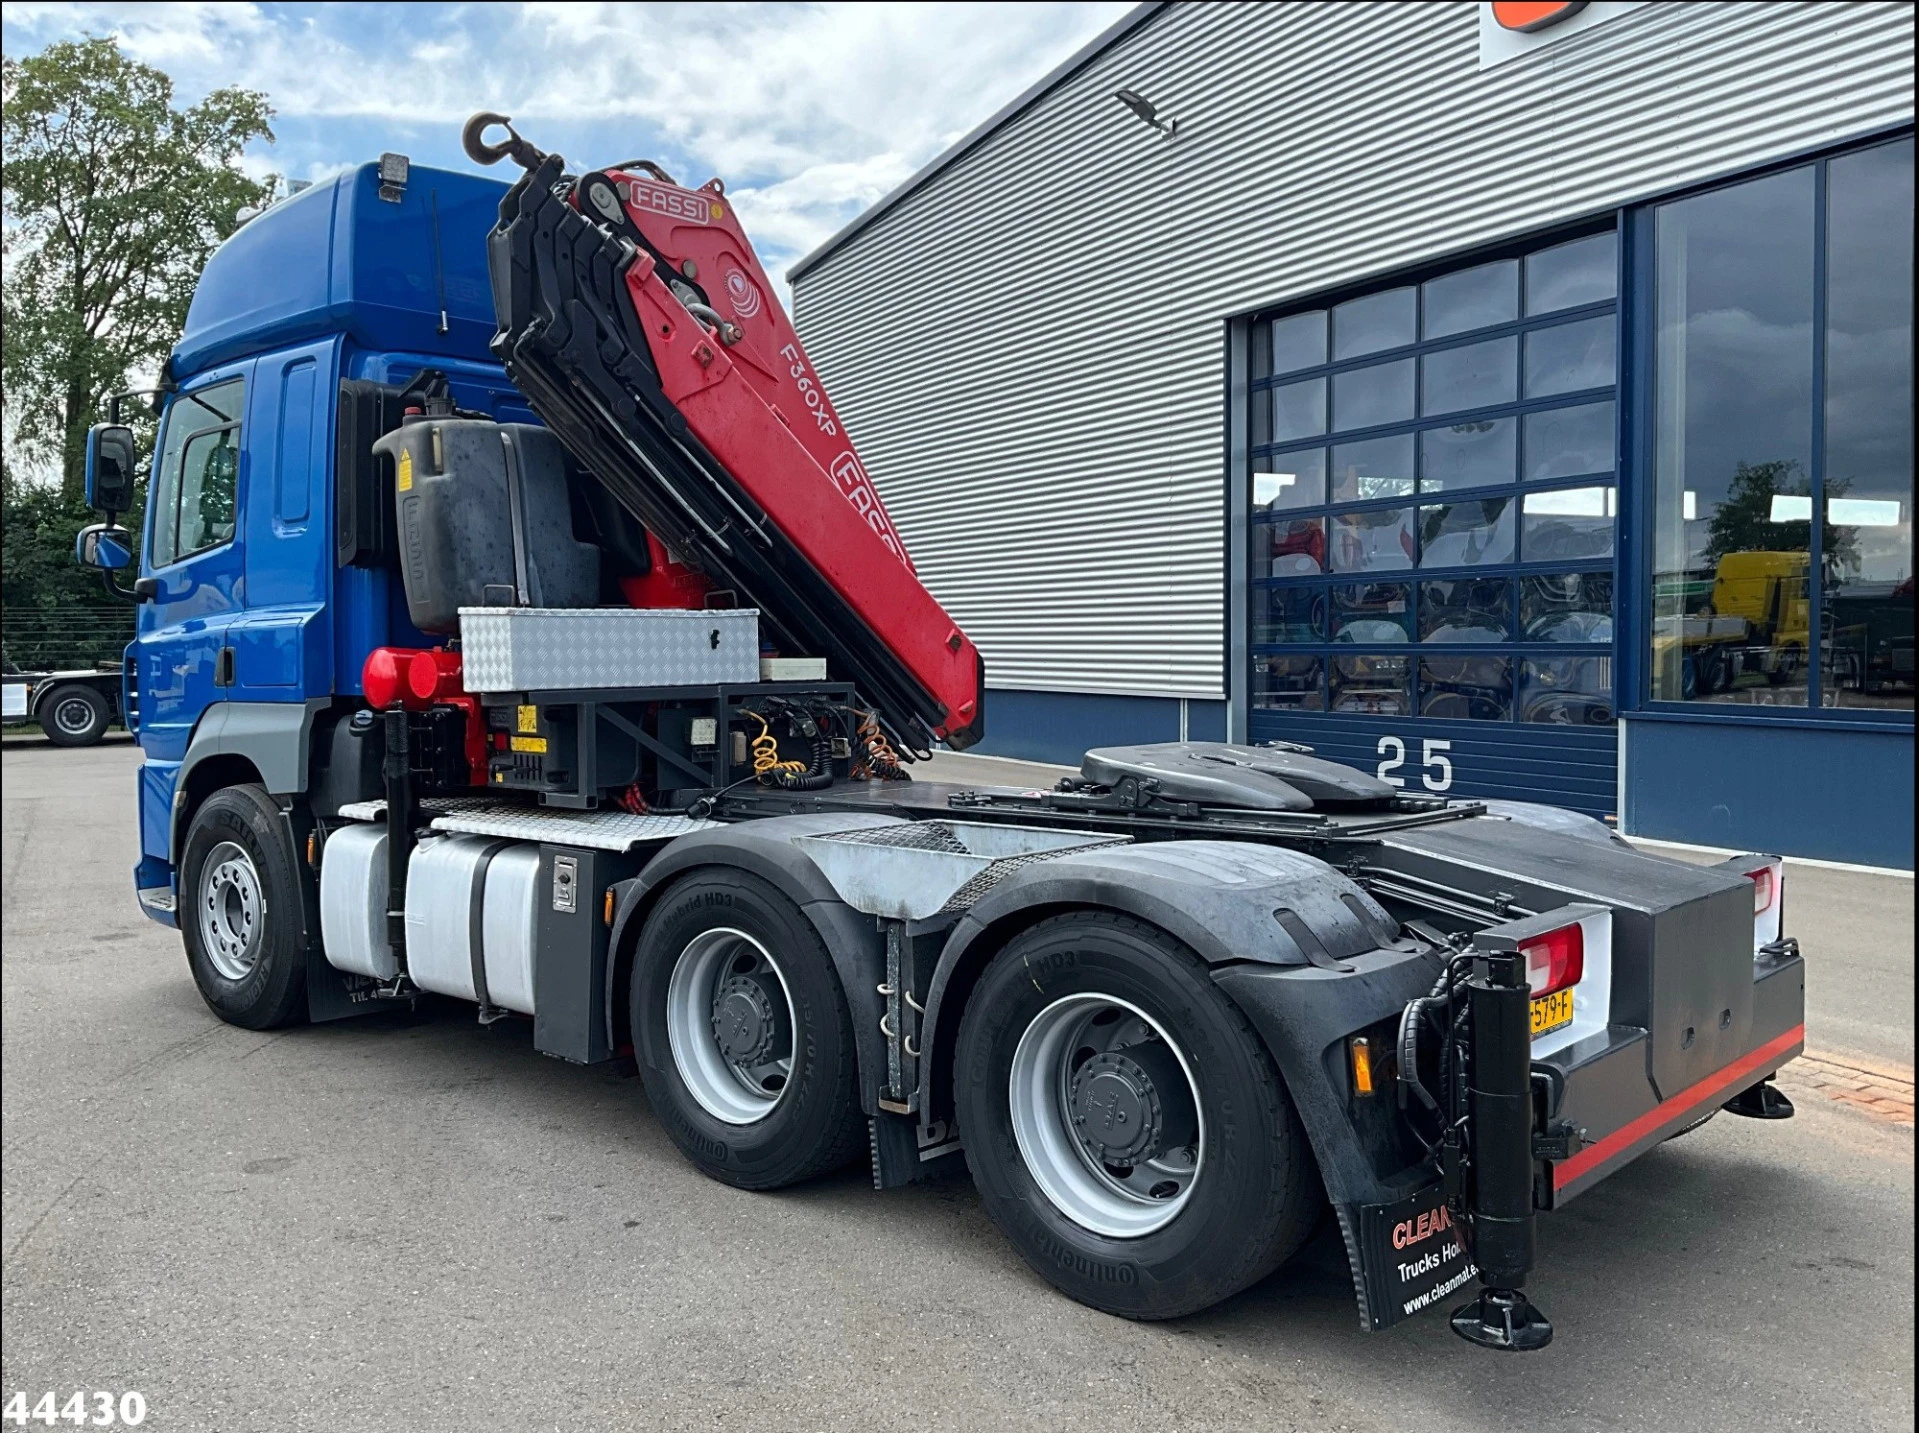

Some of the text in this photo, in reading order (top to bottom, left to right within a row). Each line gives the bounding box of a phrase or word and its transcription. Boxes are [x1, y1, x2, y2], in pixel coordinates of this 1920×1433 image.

[638, 187, 703, 219] FASSI
[780, 343, 837, 437] F360XP
[1377, 736, 1452, 791] 25
[702, 891, 732, 909] HD3
[1036, 949, 1077, 976] HD3
[1398, 1241, 1461, 1283] Trucks Hol
